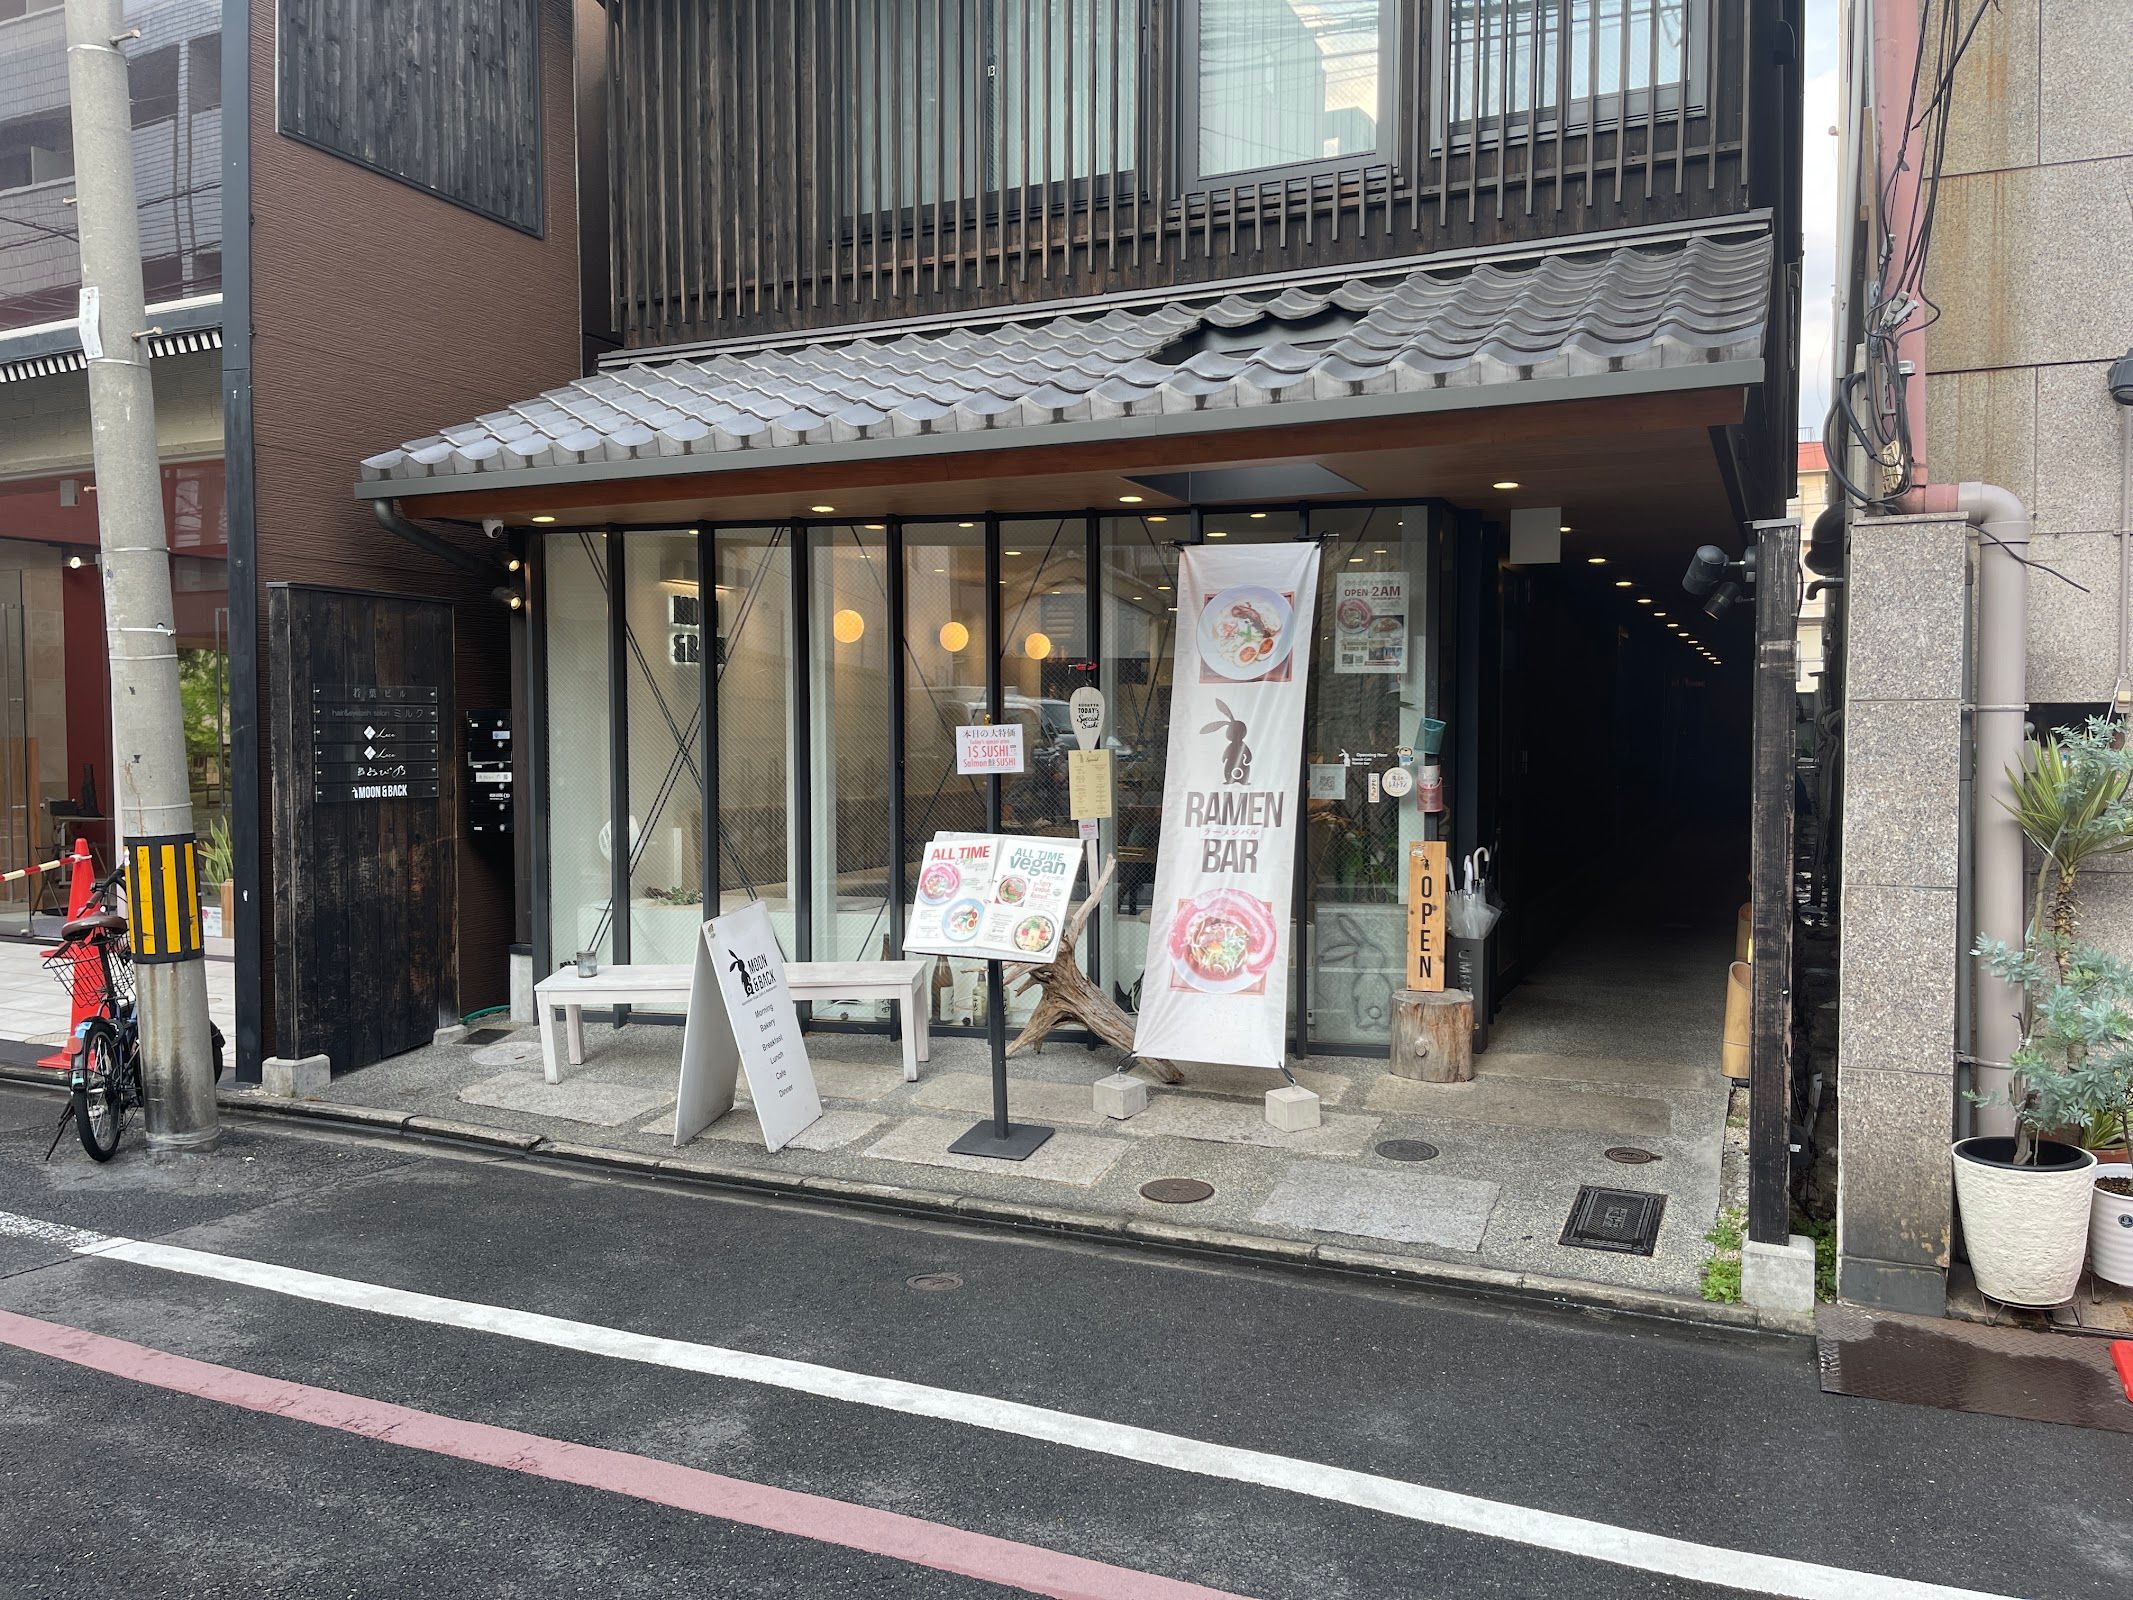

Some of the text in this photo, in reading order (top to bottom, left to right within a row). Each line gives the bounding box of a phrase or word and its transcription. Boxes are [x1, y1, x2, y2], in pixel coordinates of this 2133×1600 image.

[1344, 588, 1369, 597] OPEN
[981, 744, 1009, 758] SUSHI
[963, 757, 988, 768] Salmon
[996, 757, 1016, 768] SUSHI
[1184, 791, 1284, 828] RAMEN
[1203, 828, 1260, 836] ラーメンバル
[931, 845, 991, 861] ALL TIME
[1014, 847, 1065, 861] ALL TIME
[1201, 838, 1259, 874] BAR
[1010, 856, 1066, 877] vegan
[1420, 875, 1433, 979] OPEN
[747, 952, 768, 975] MOON
[754, 1004, 774, 1018] Morning
[760, 1019, 776, 1032] Bakery
[761, 1033, 784, 1052] Breakfast
[769, 1051, 785, 1065] Lunch
[778, 1084, 793, 1098] Dinner
